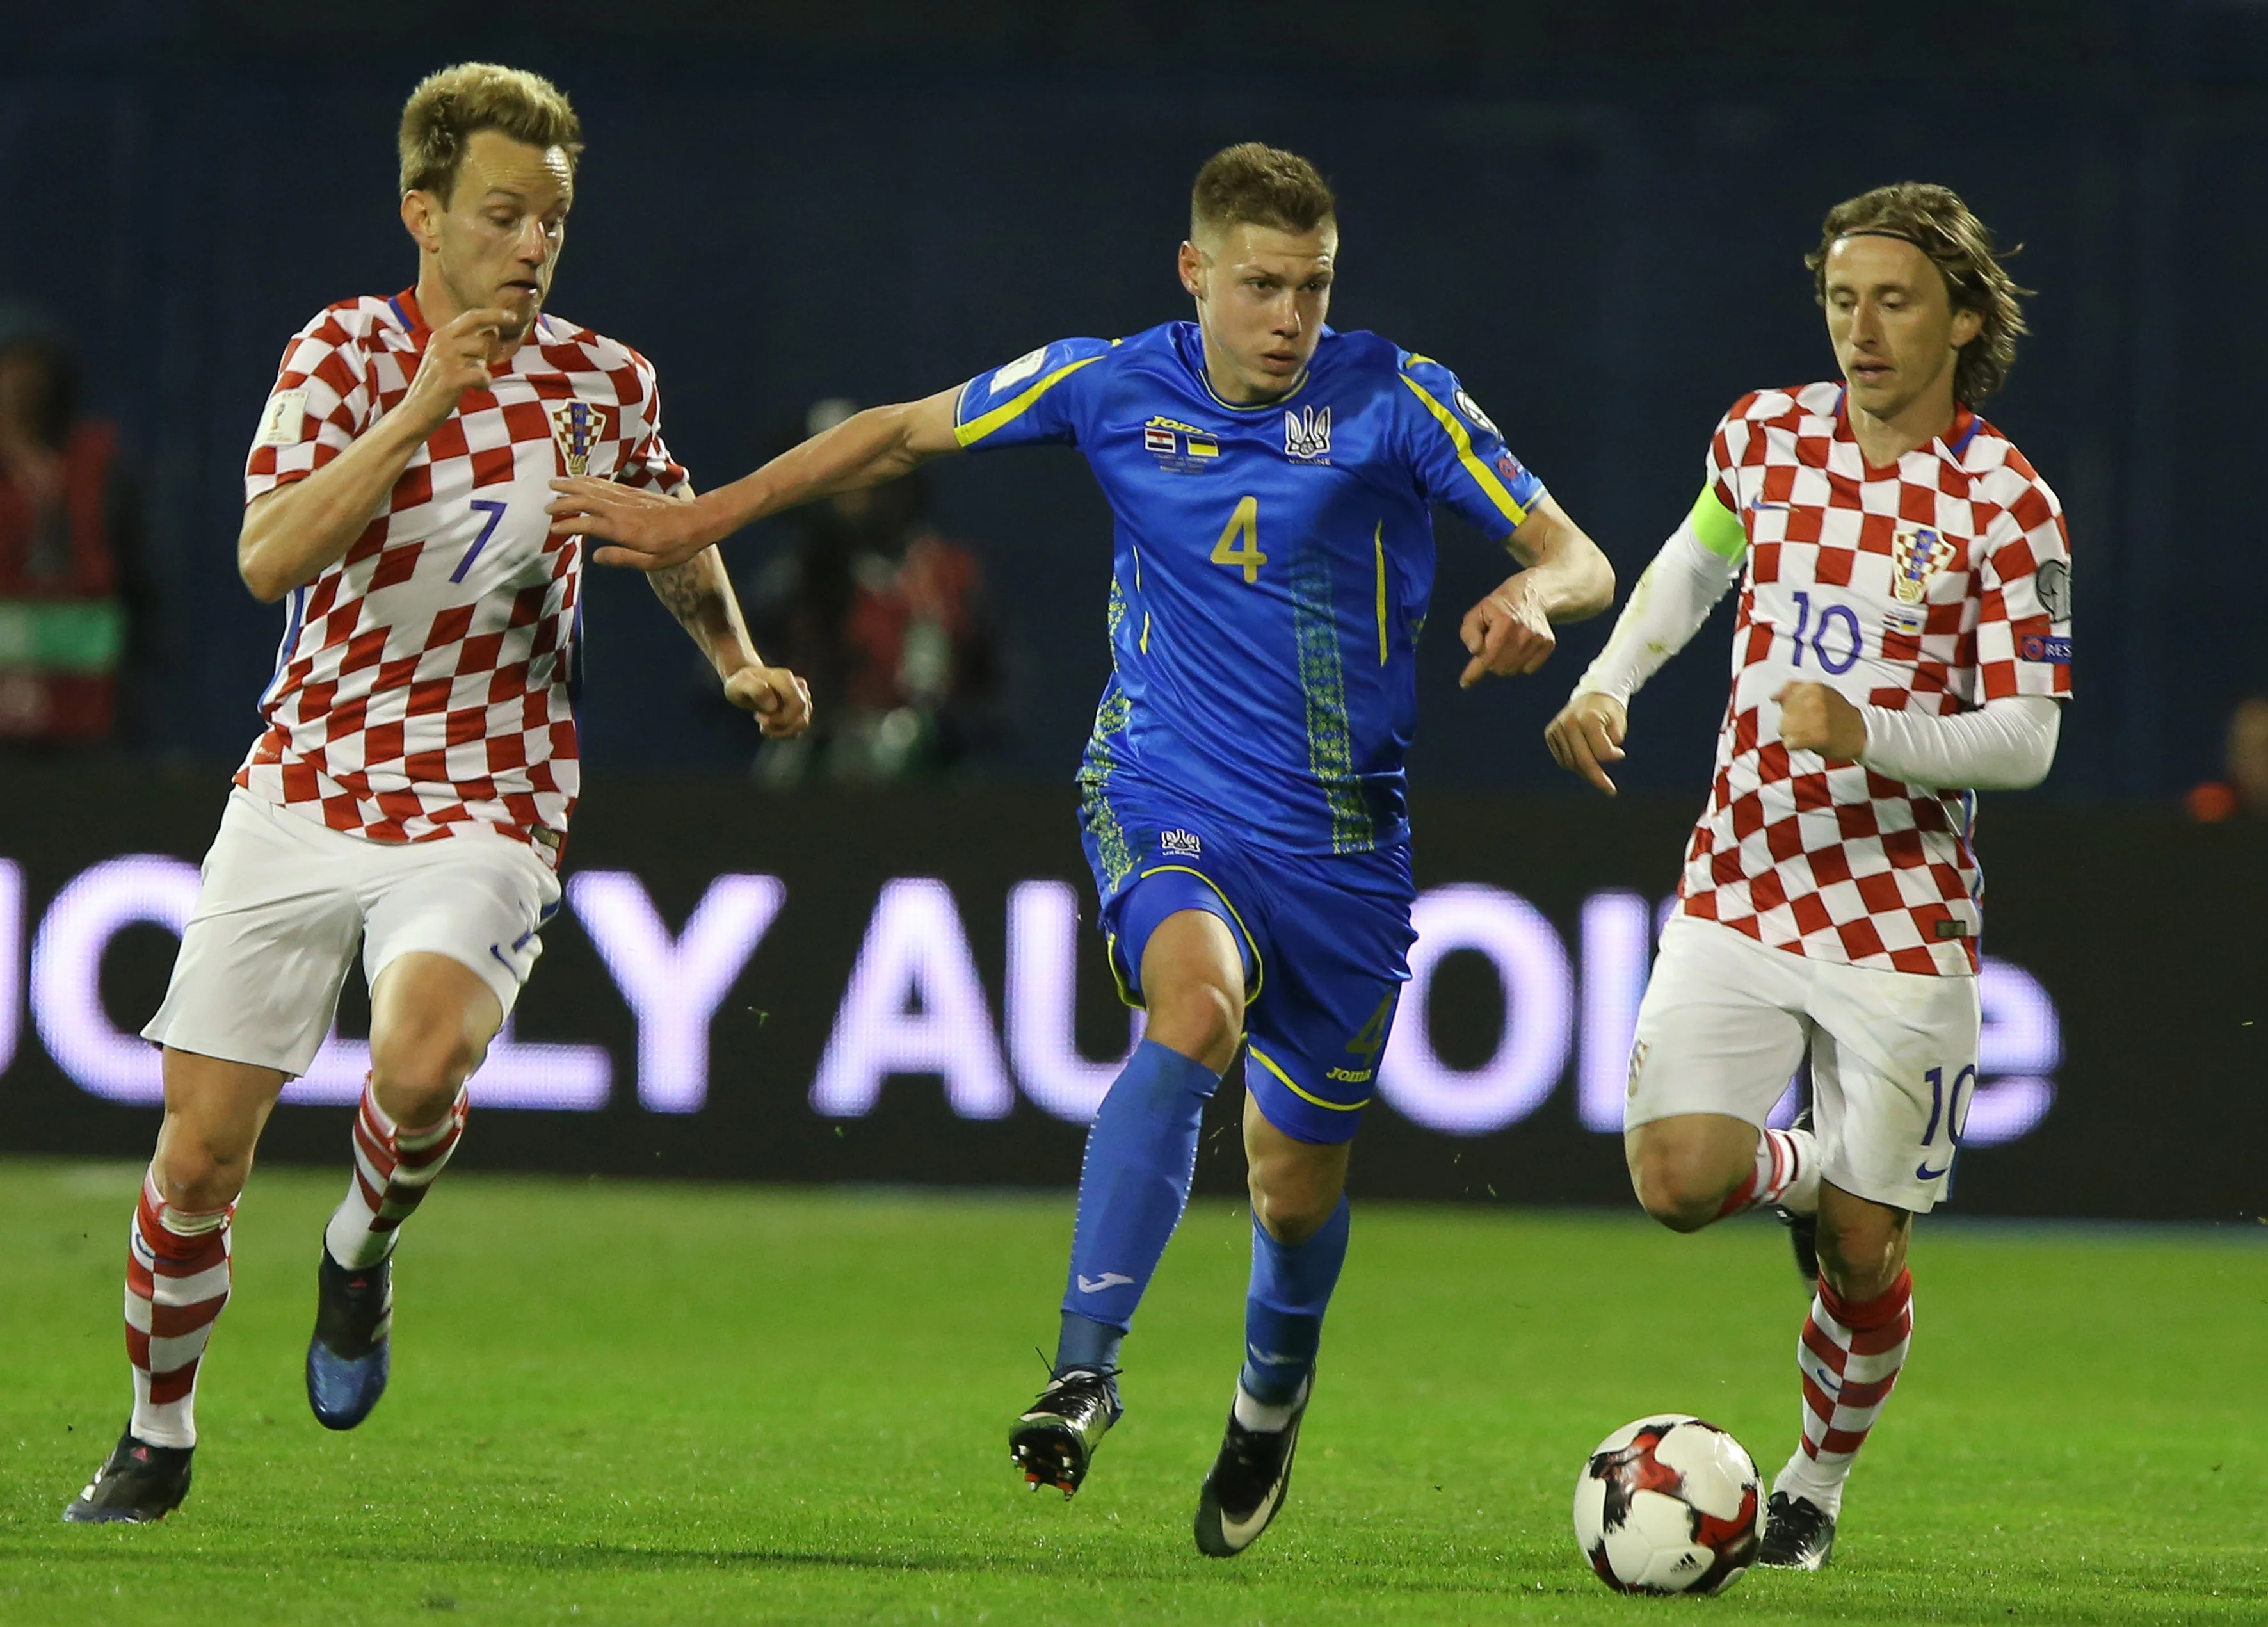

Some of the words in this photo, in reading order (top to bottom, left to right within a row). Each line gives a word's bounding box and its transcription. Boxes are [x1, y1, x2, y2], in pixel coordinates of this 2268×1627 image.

[449, 499, 508, 583] 7
[1210, 496, 1267, 583] 4
[1793, 592, 1862, 674] 10
[1346, 990, 1394, 1067] 4
[1921, 1064, 1976, 1147] 10
